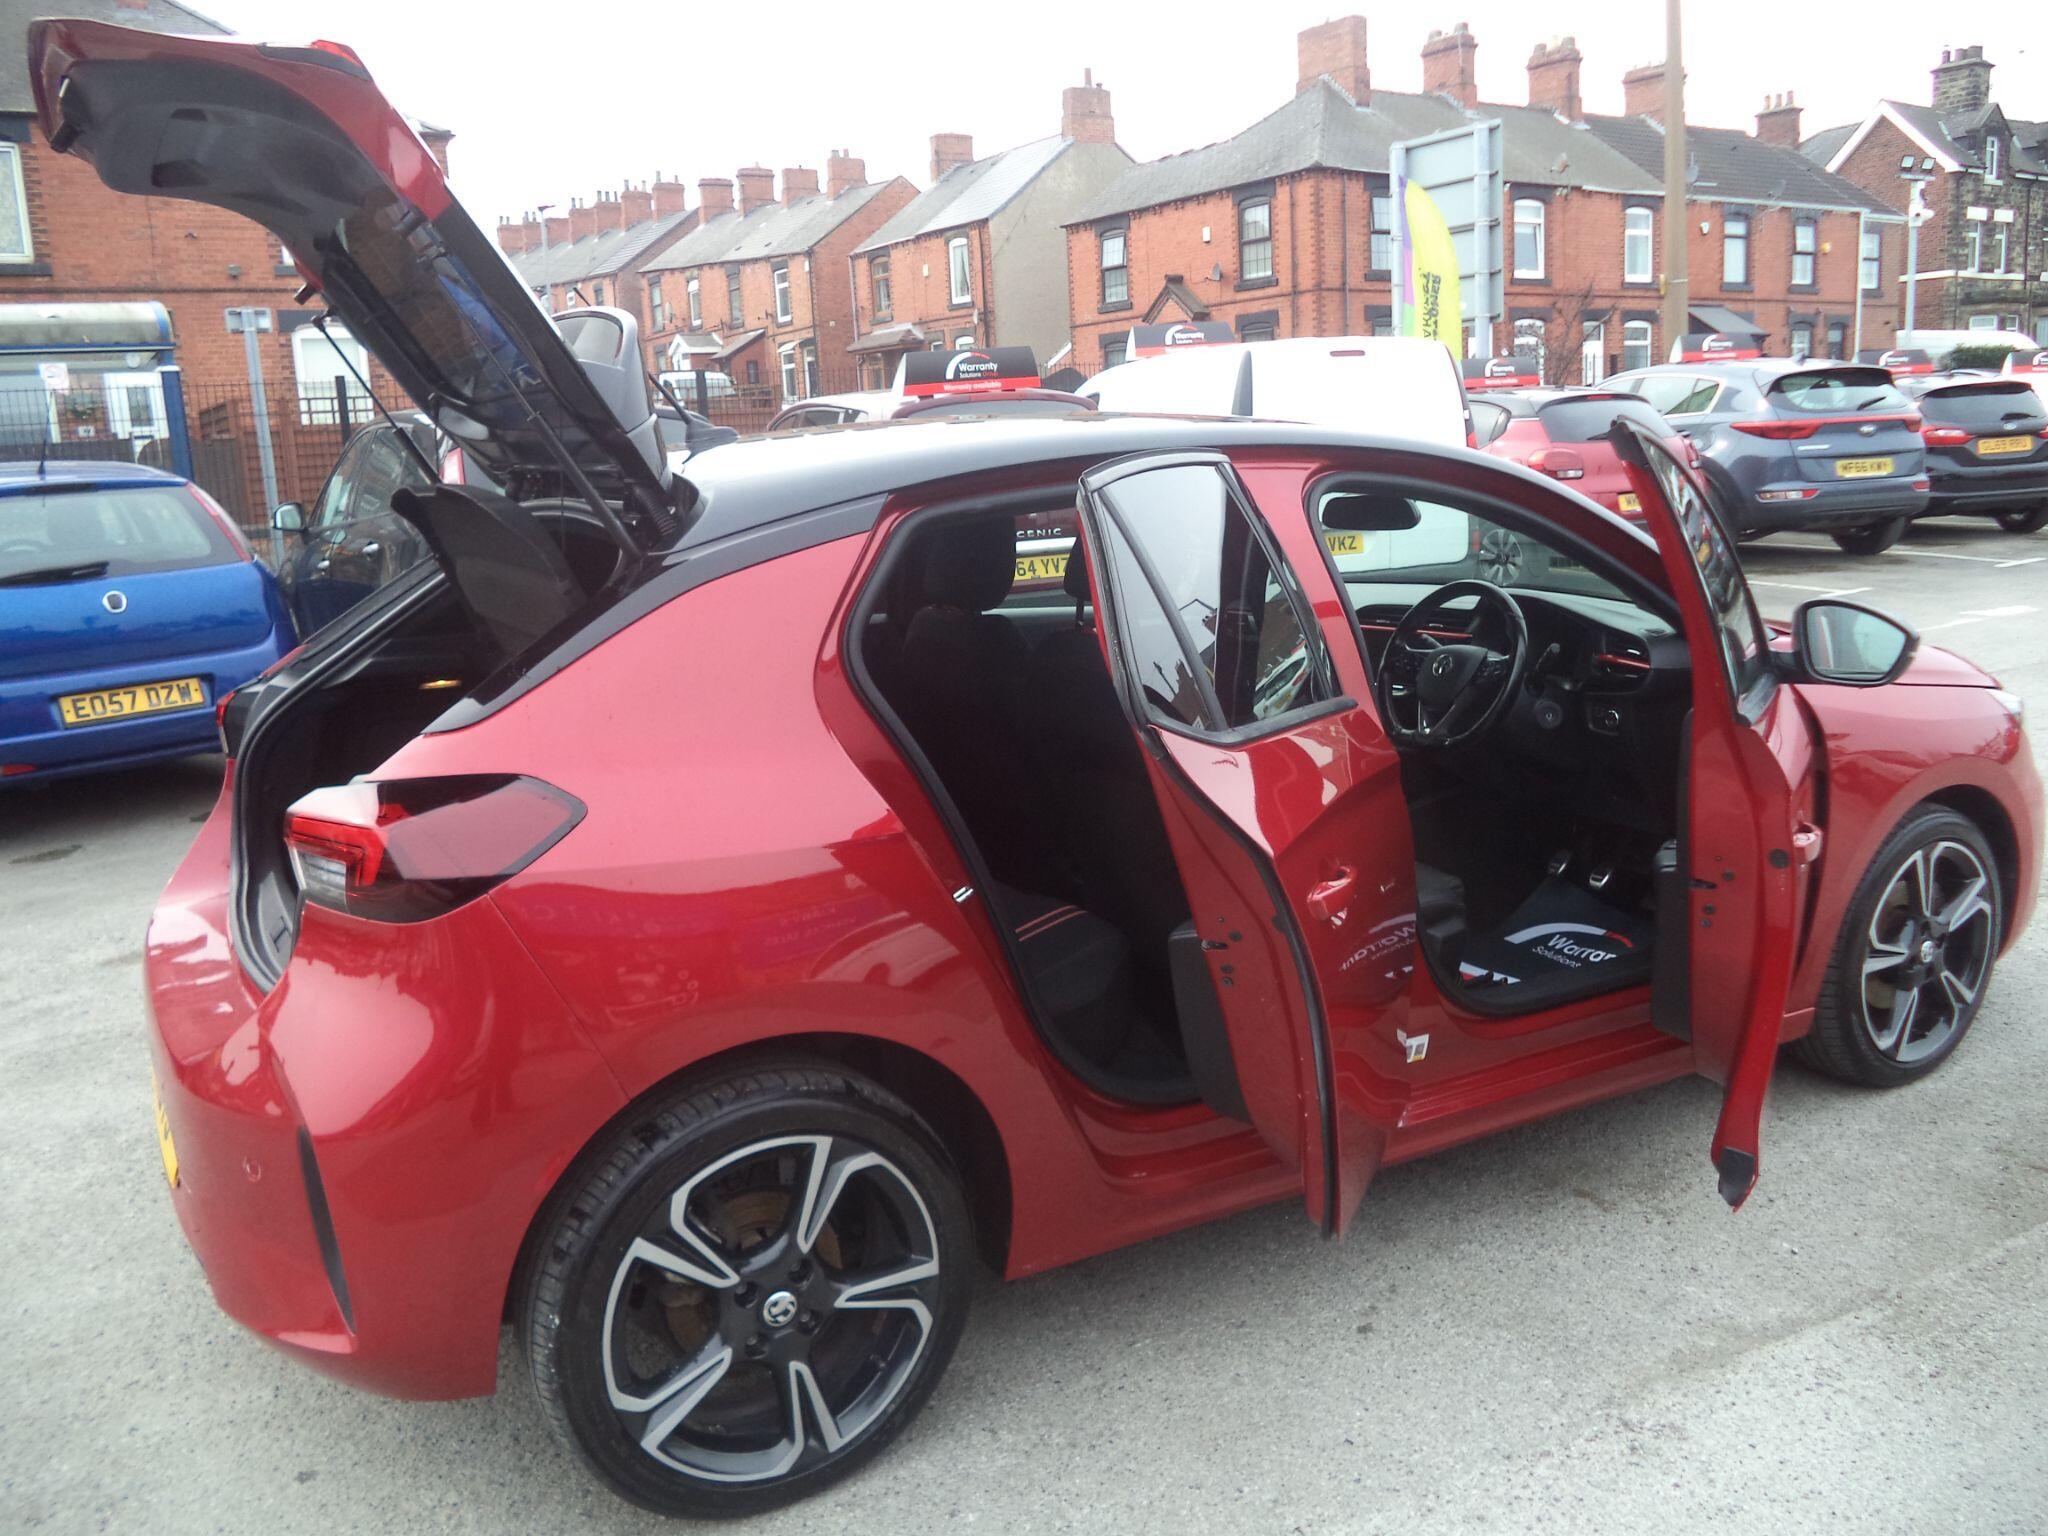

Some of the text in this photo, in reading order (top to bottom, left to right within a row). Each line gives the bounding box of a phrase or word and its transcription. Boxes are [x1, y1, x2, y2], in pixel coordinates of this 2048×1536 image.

[958, 362, 998, 373] Warranty
[1016, 527, 1062, 538] CENIC
[1328, 535, 1357, 551] VKZ
[72, 682, 193, 719] EO57 DZW
